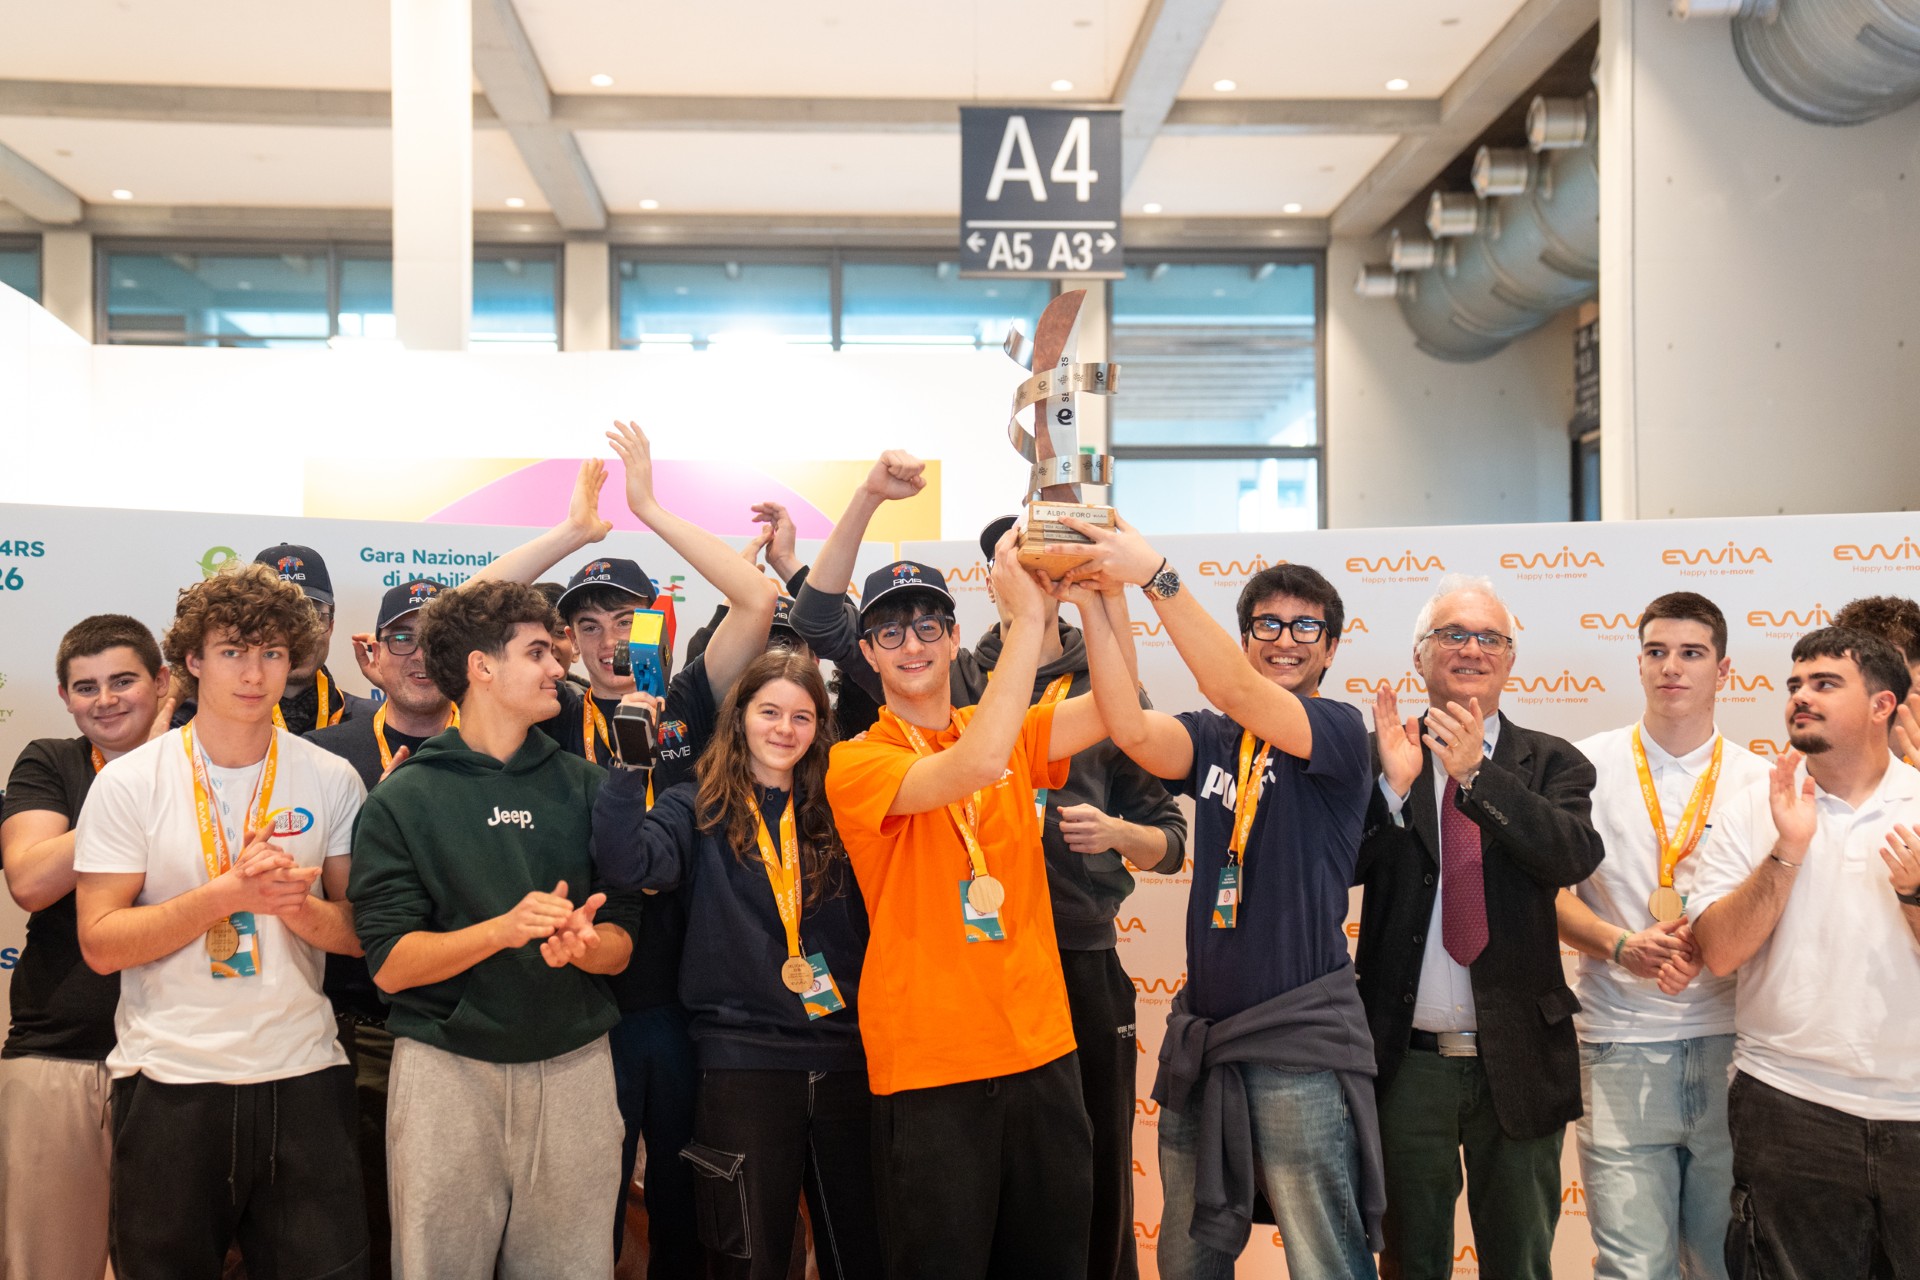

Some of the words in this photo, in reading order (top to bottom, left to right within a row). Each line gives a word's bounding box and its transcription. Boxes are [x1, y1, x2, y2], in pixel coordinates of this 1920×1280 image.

[985, 115, 1099, 202] A4
[987, 231, 1034, 270] A5
[1047, 231, 1093, 270] A3
[360, 547, 405, 564] Gara
[1680, 569, 1706, 577] Happy
[1852, 565, 1881, 573] Happy
[383, 570, 400, 587] di
[409, 572, 471, 588] Mbilit
[1362, 576, 1387, 585] Happy
[1517, 573, 1542, 581] Happy
[1214, 580, 1237, 588] Happy
[1598, 633, 1624, 641] Happy
[1766, 631, 1793, 639] Happy
[1142, 640, 1165, 648] Happy
[661, 745, 690, 761] RMB
[1140, 877, 1163, 885] Happy
[1139, 1119, 1158, 1127] Happ
